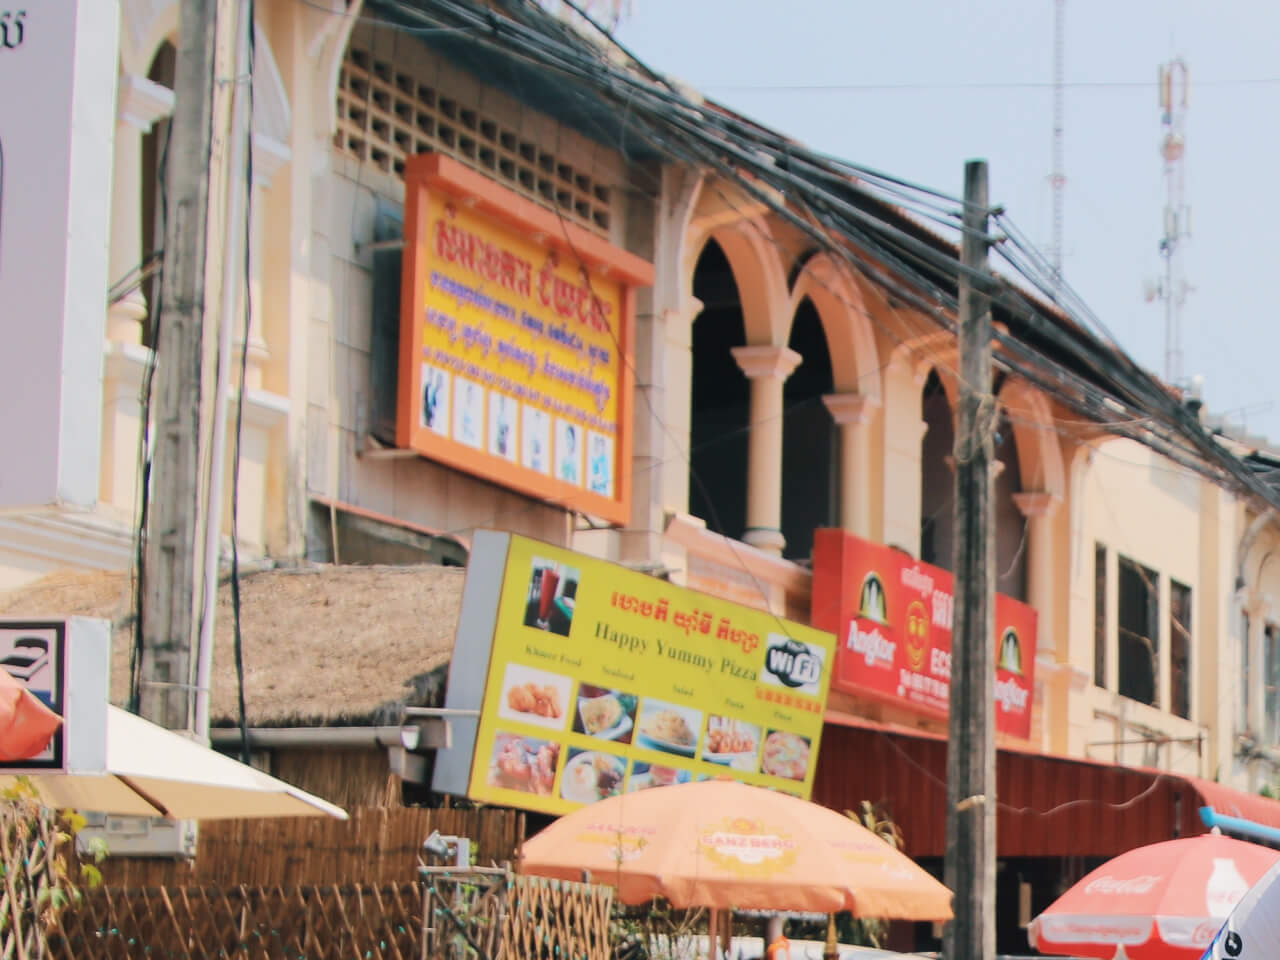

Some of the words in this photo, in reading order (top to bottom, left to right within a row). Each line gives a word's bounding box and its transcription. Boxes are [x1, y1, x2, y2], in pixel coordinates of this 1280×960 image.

[595, 621, 648, 655] Happy
[656, 638, 713, 672] Yummy
[720, 657, 757, 681] Pizza
